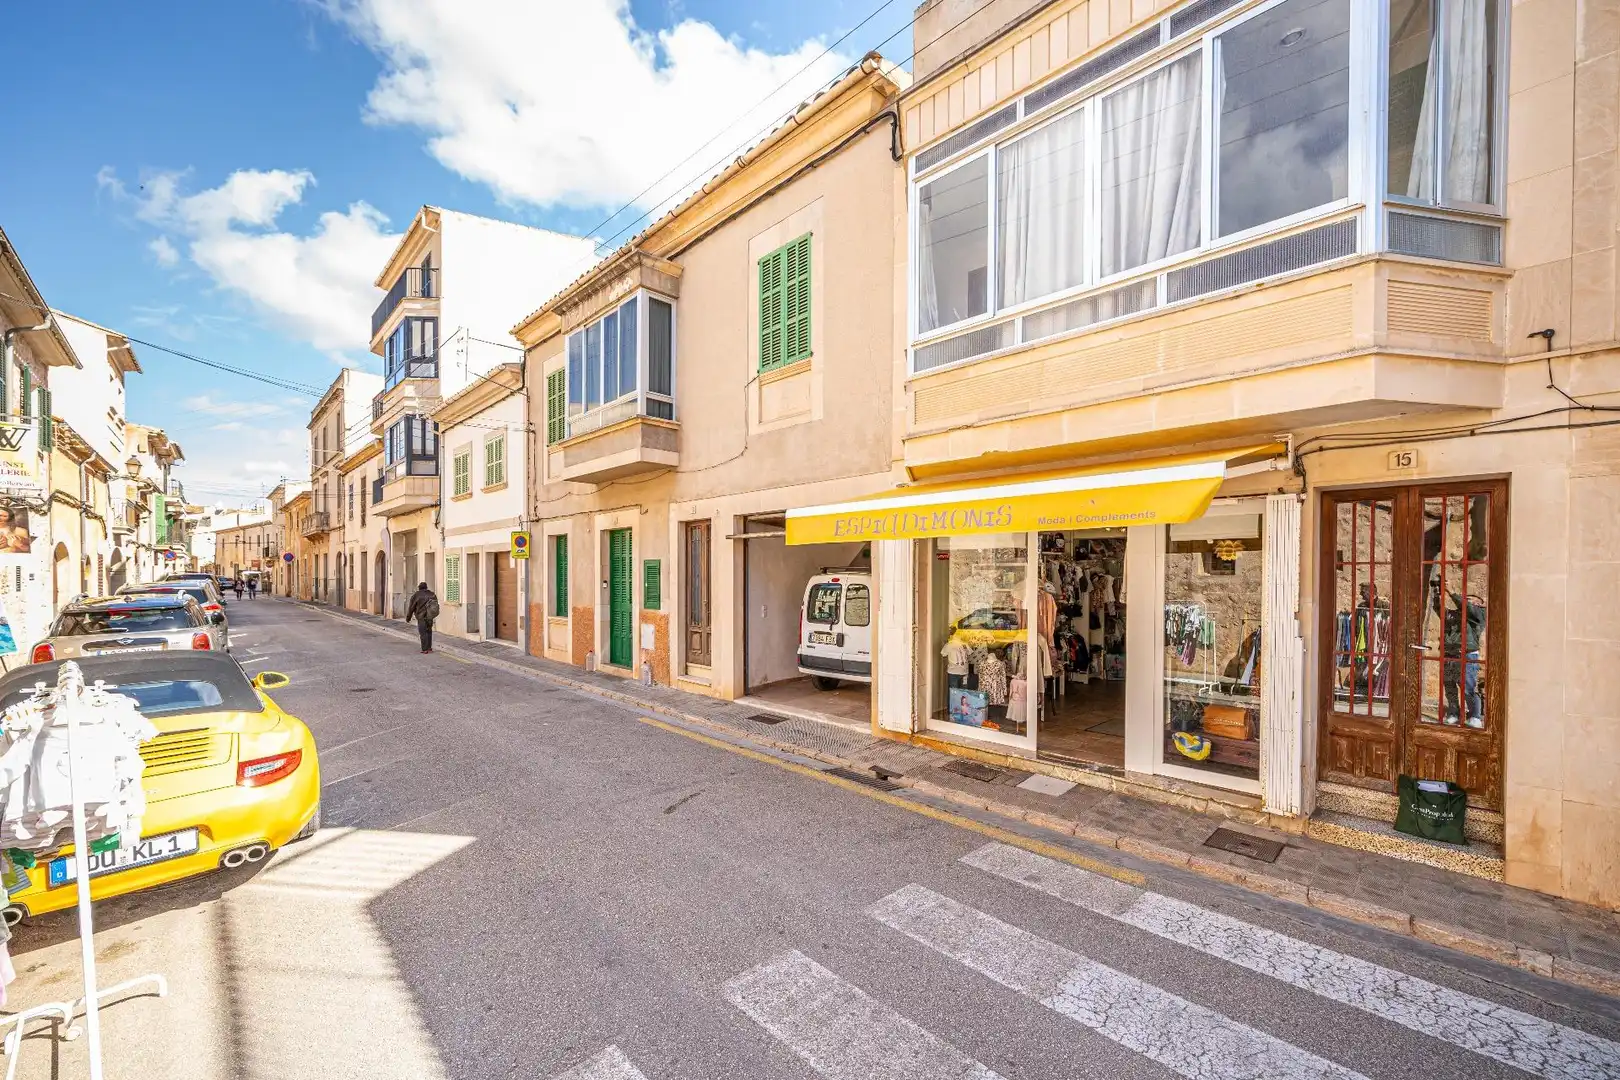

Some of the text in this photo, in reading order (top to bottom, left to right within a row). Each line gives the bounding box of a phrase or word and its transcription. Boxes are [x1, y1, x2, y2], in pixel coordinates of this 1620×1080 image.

[1395, 452, 1412, 467] 15
[1038, 516, 1066, 525] Moda
[1075, 510, 1156, 524] Complements
[133, 841, 162, 861] KL
[168, 836, 181, 852] 1
